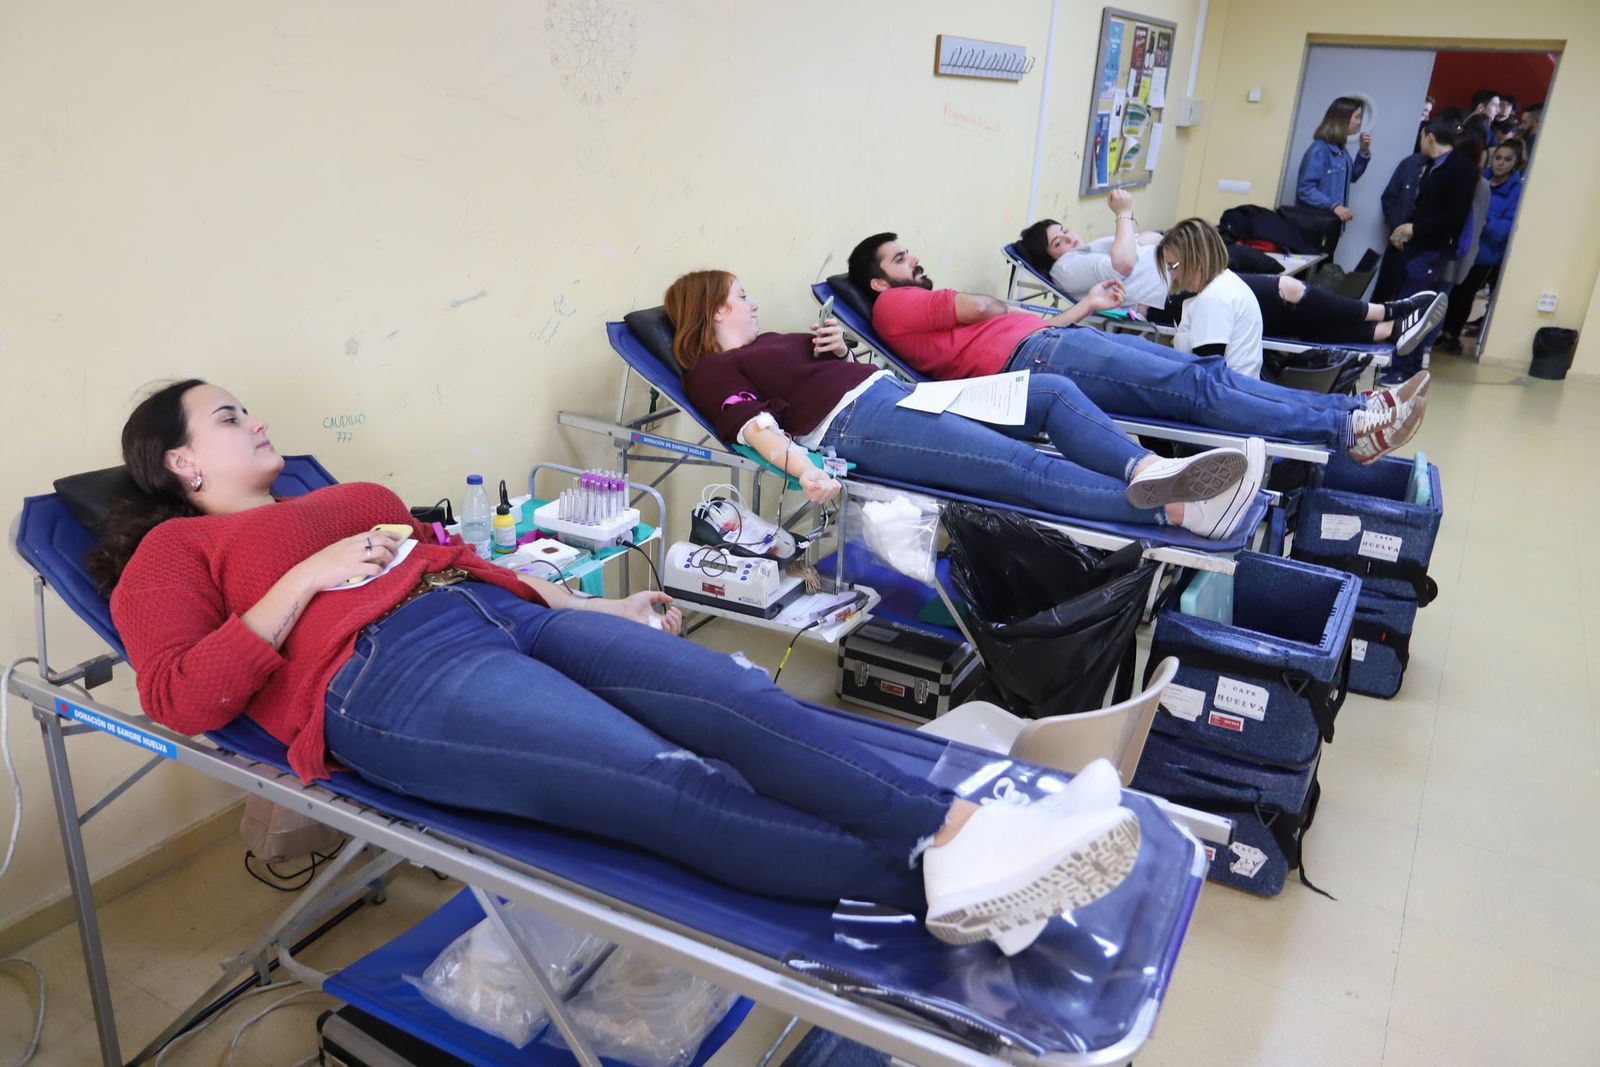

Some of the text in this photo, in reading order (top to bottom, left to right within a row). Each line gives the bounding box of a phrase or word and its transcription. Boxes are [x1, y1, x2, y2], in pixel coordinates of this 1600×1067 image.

[643, 437, 665, 447] DONACIÓN
[689, 447, 705, 456] HUELVA
[1362, 541, 1398, 553] HUELVA
[1232, 686, 1256, 696] CATS
[1217, 694, 1264, 712] HUELVA
[74, 709, 167, 753] DONACIÓN DE SANGRE HUELVA
